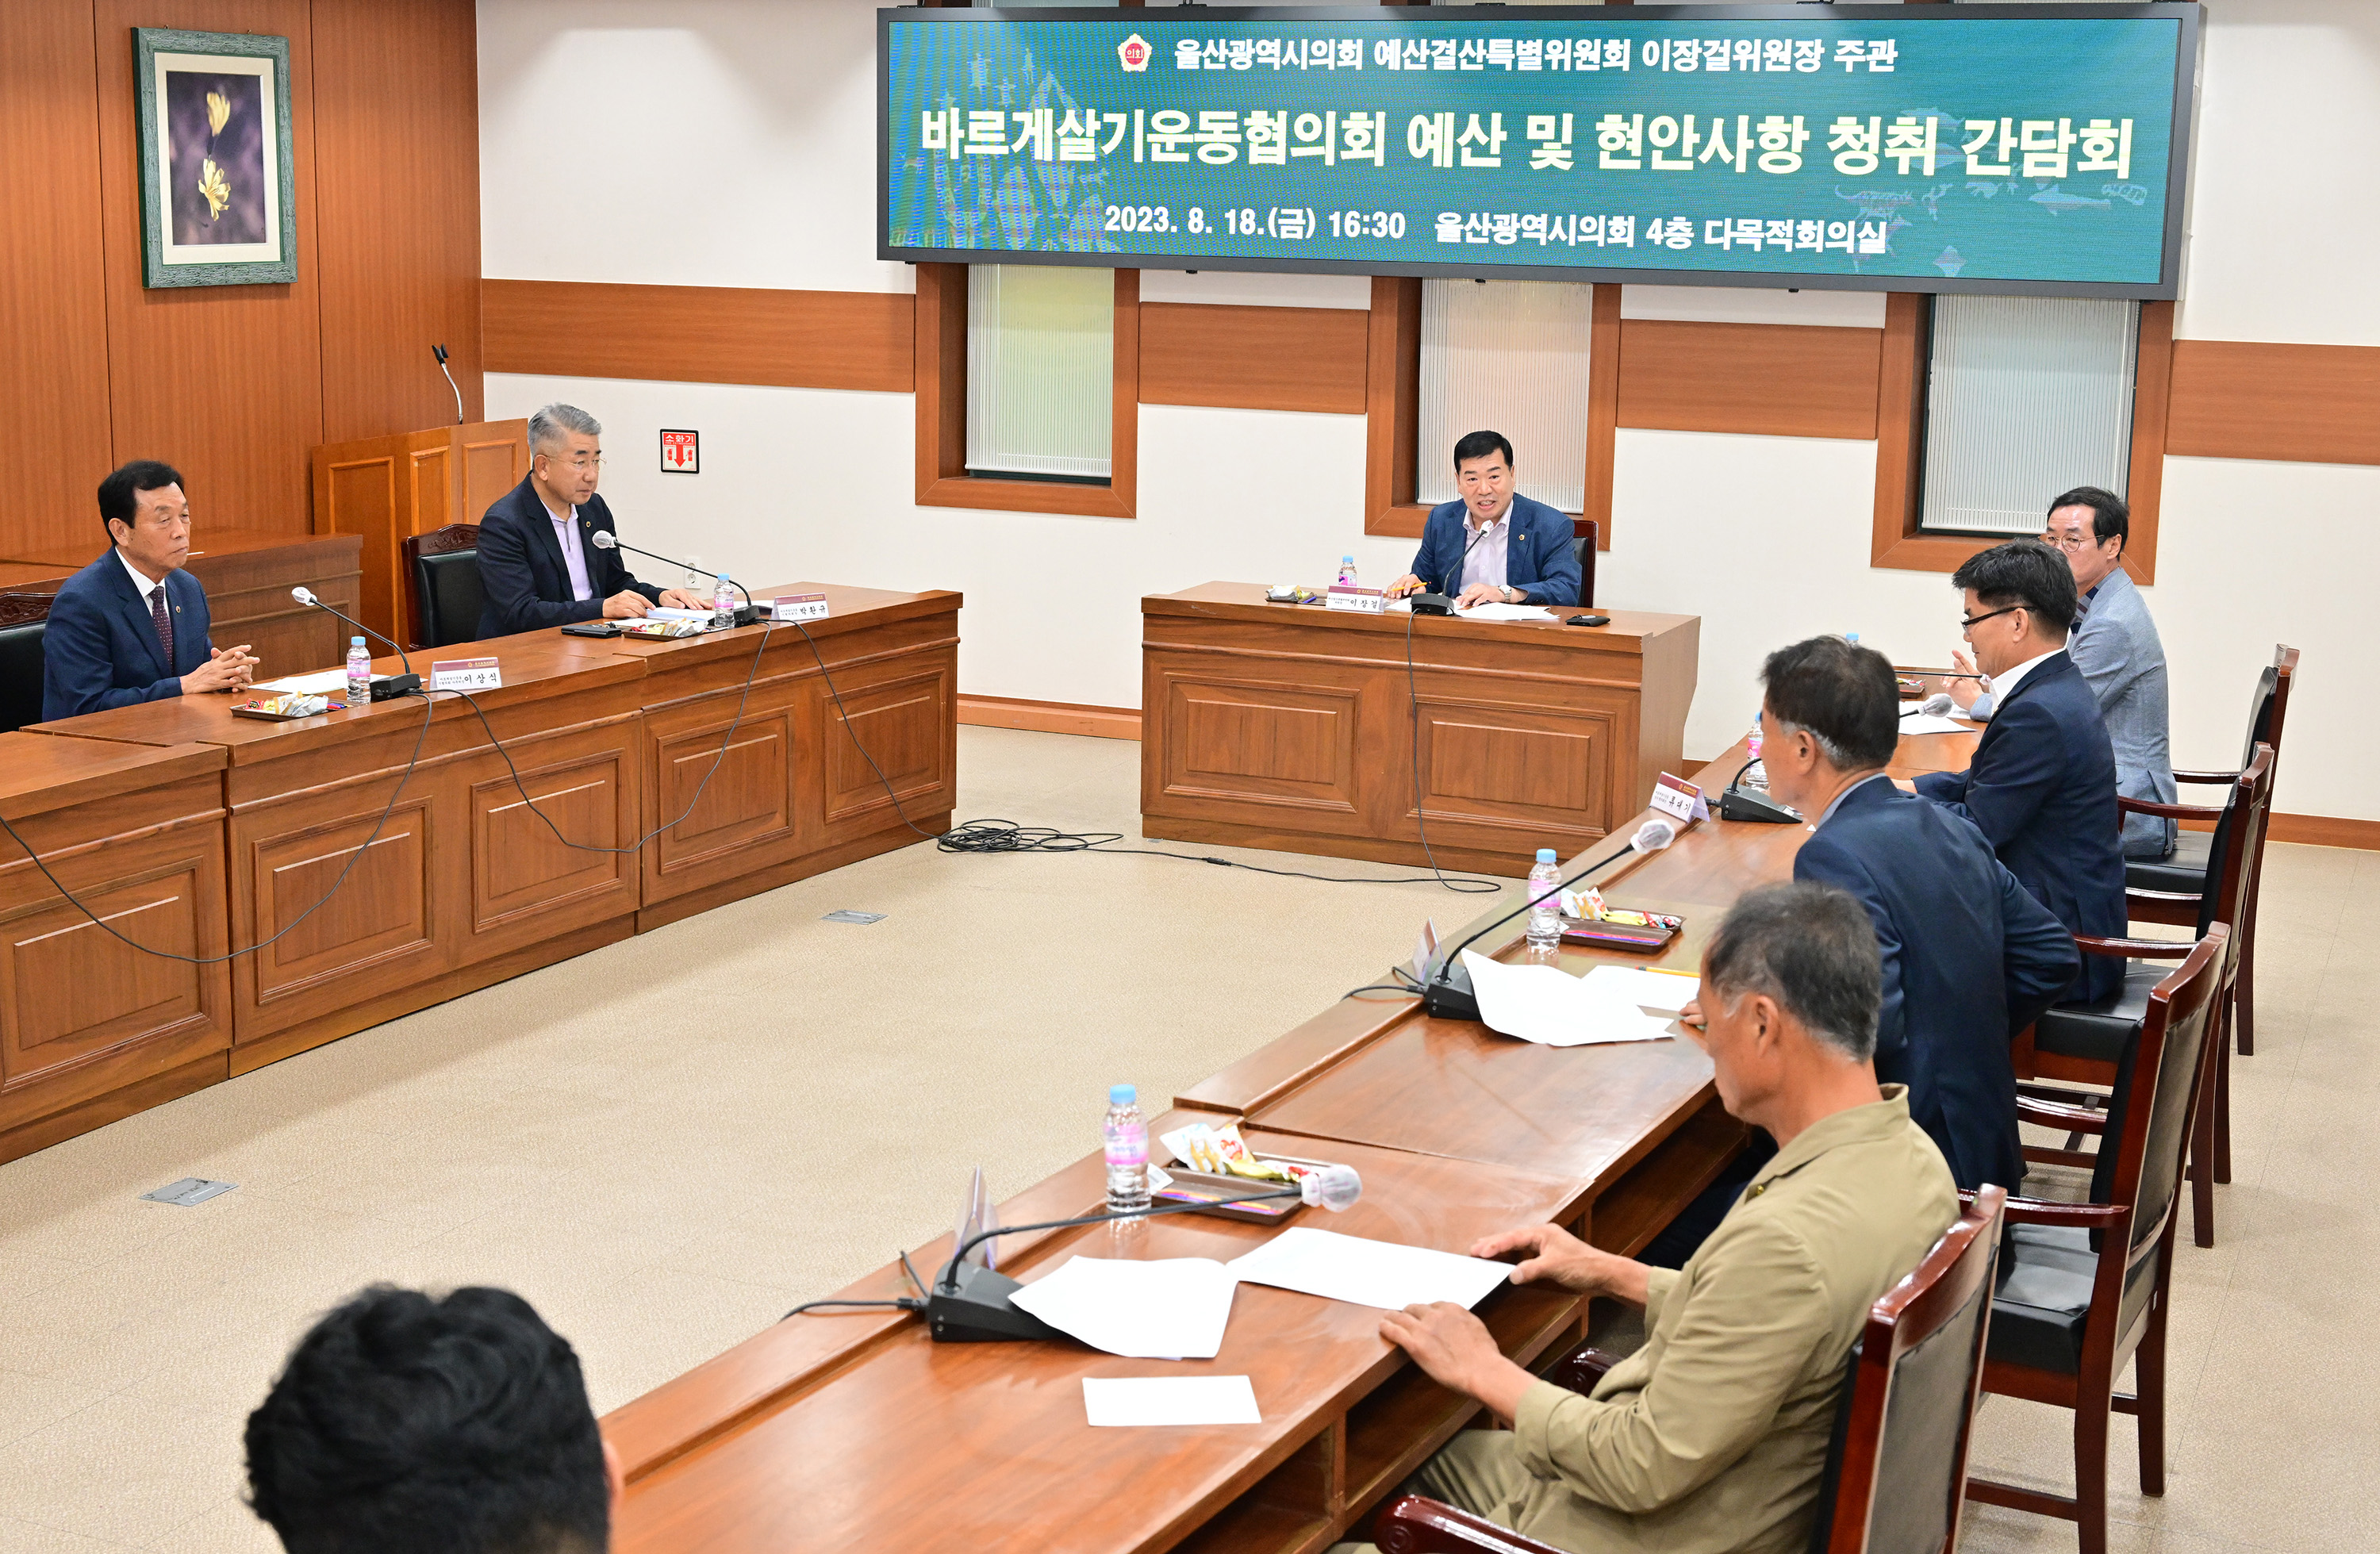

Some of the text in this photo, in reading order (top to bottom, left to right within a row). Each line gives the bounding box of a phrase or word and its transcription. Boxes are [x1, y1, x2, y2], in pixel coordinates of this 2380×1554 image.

[1127, 48, 1143, 59] 의회
[1174, 38, 1898, 73] 울산광역시의회 예산결산특별위원회 이장걸위원장 주관
[921, 107, 2133, 179] 바르게살기운동협의회 예산 및 현안사항 청취 간담회
[1104, 205, 1178, 233] 2023.
[1188, 207, 1213, 235] 8.
[1329, 210, 1406, 239] 16:30
[1434, 212, 1635, 247] 울산광역시의회
[1645, 217, 1695, 250] 4층
[1704, 217, 1887, 254] 다목적회의실
[665, 434, 694, 443] 소화기
